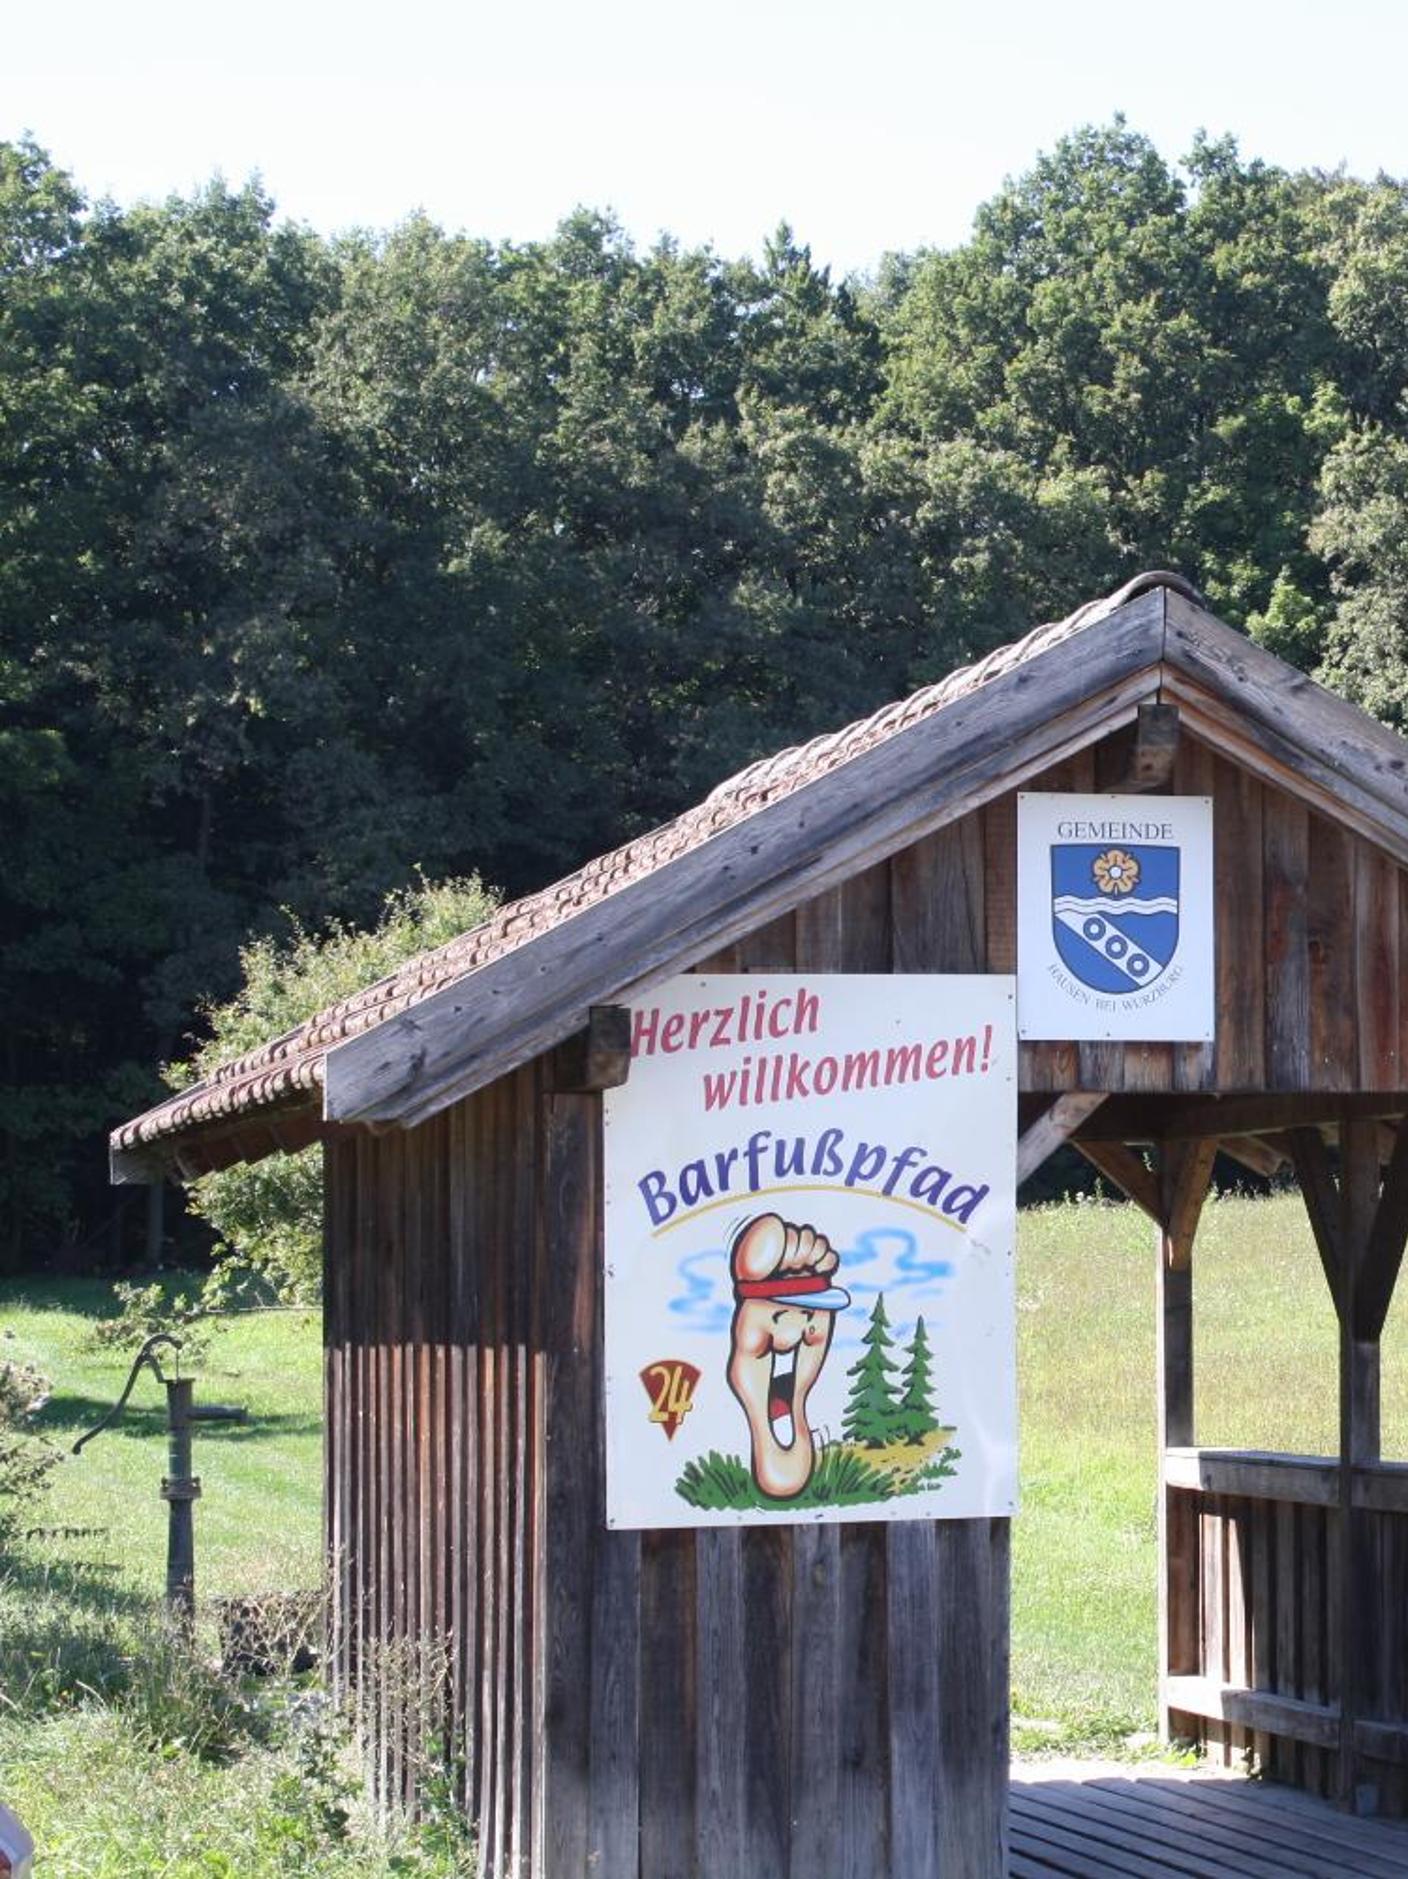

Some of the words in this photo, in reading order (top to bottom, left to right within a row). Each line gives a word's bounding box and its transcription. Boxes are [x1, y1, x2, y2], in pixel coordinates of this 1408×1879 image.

[1057, 821, 1173, 840] GEMEINDE
[1046, 963, 1090, 1006] HAUSEN
[1095, 998, 1117, 1012] BEI
[630, 987, 820, 1058] Herzlich
[702, 1024, 993, 1112] willkommen!
[636, 1127, 991, 1228] Barfußpfad
[647, 1365, 694, 1425] 24
